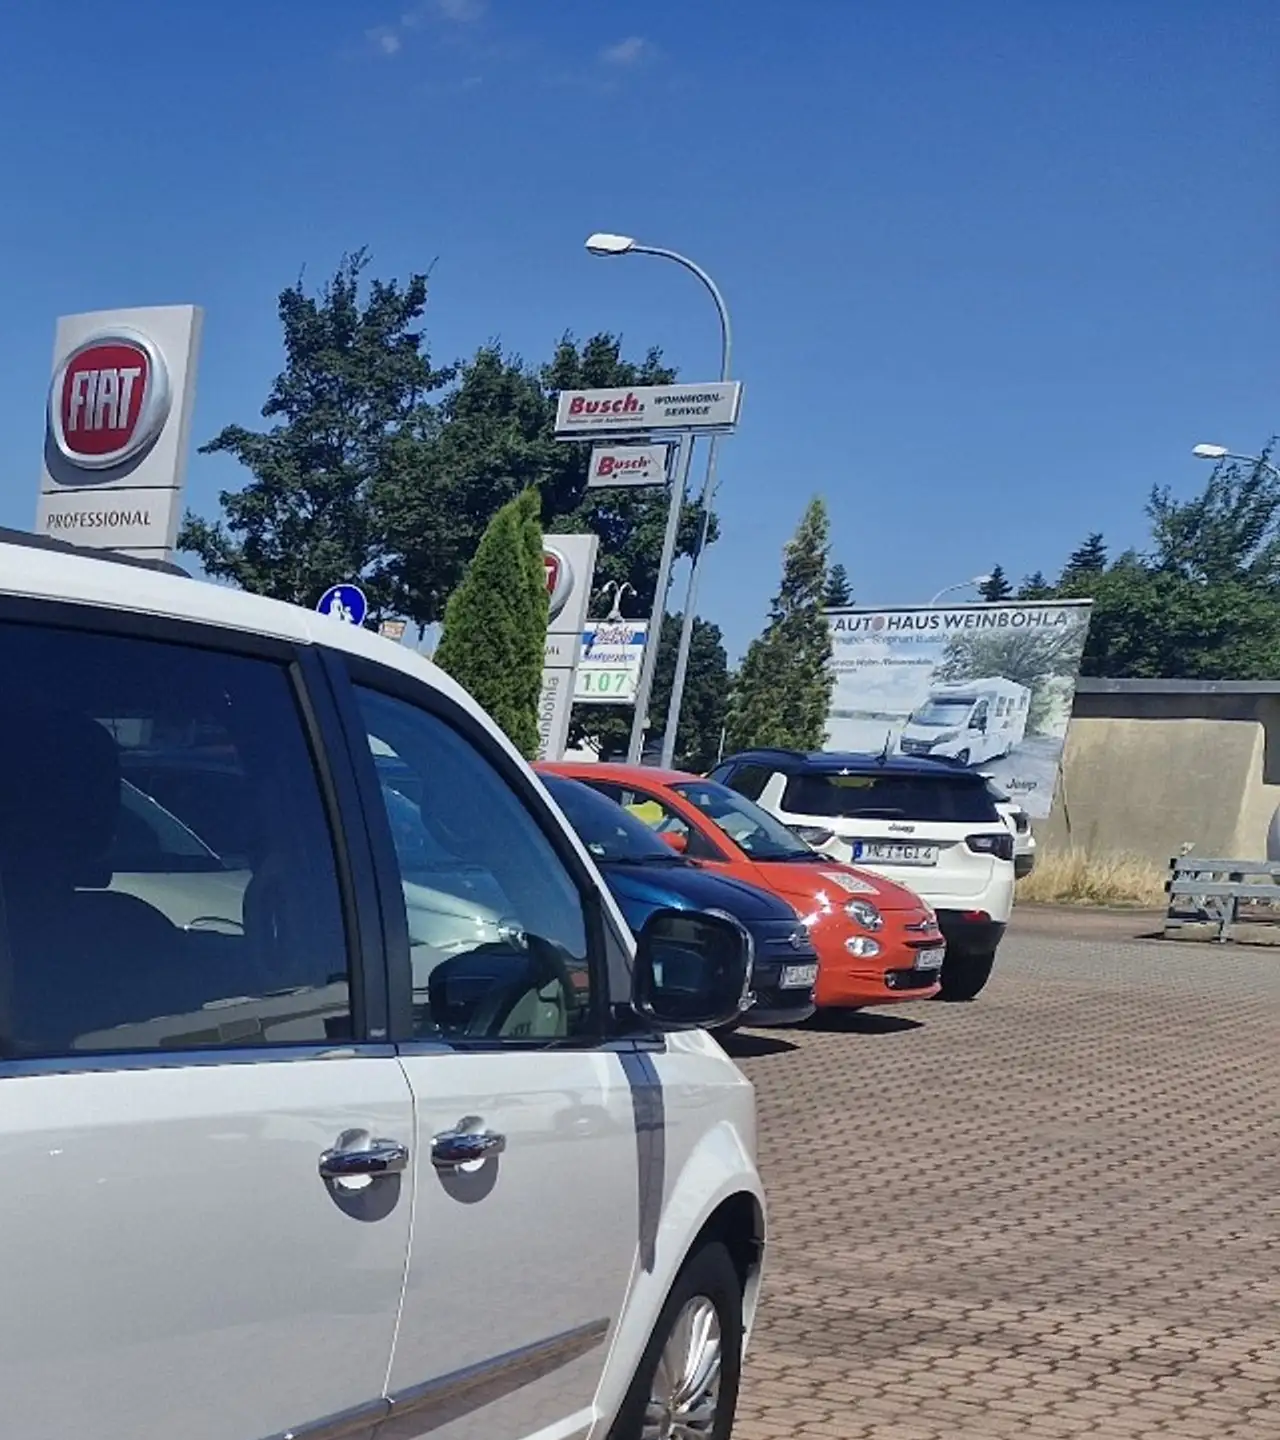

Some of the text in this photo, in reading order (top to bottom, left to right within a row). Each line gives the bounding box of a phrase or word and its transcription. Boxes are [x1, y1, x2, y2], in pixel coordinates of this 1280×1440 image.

[68, 367, 142, 432] FIAT
[663, 405, 713, 418] SERVICE
[45, 509, 152, 531] PROFESSIONAL
[582, 671, 629, 694] 1.07
